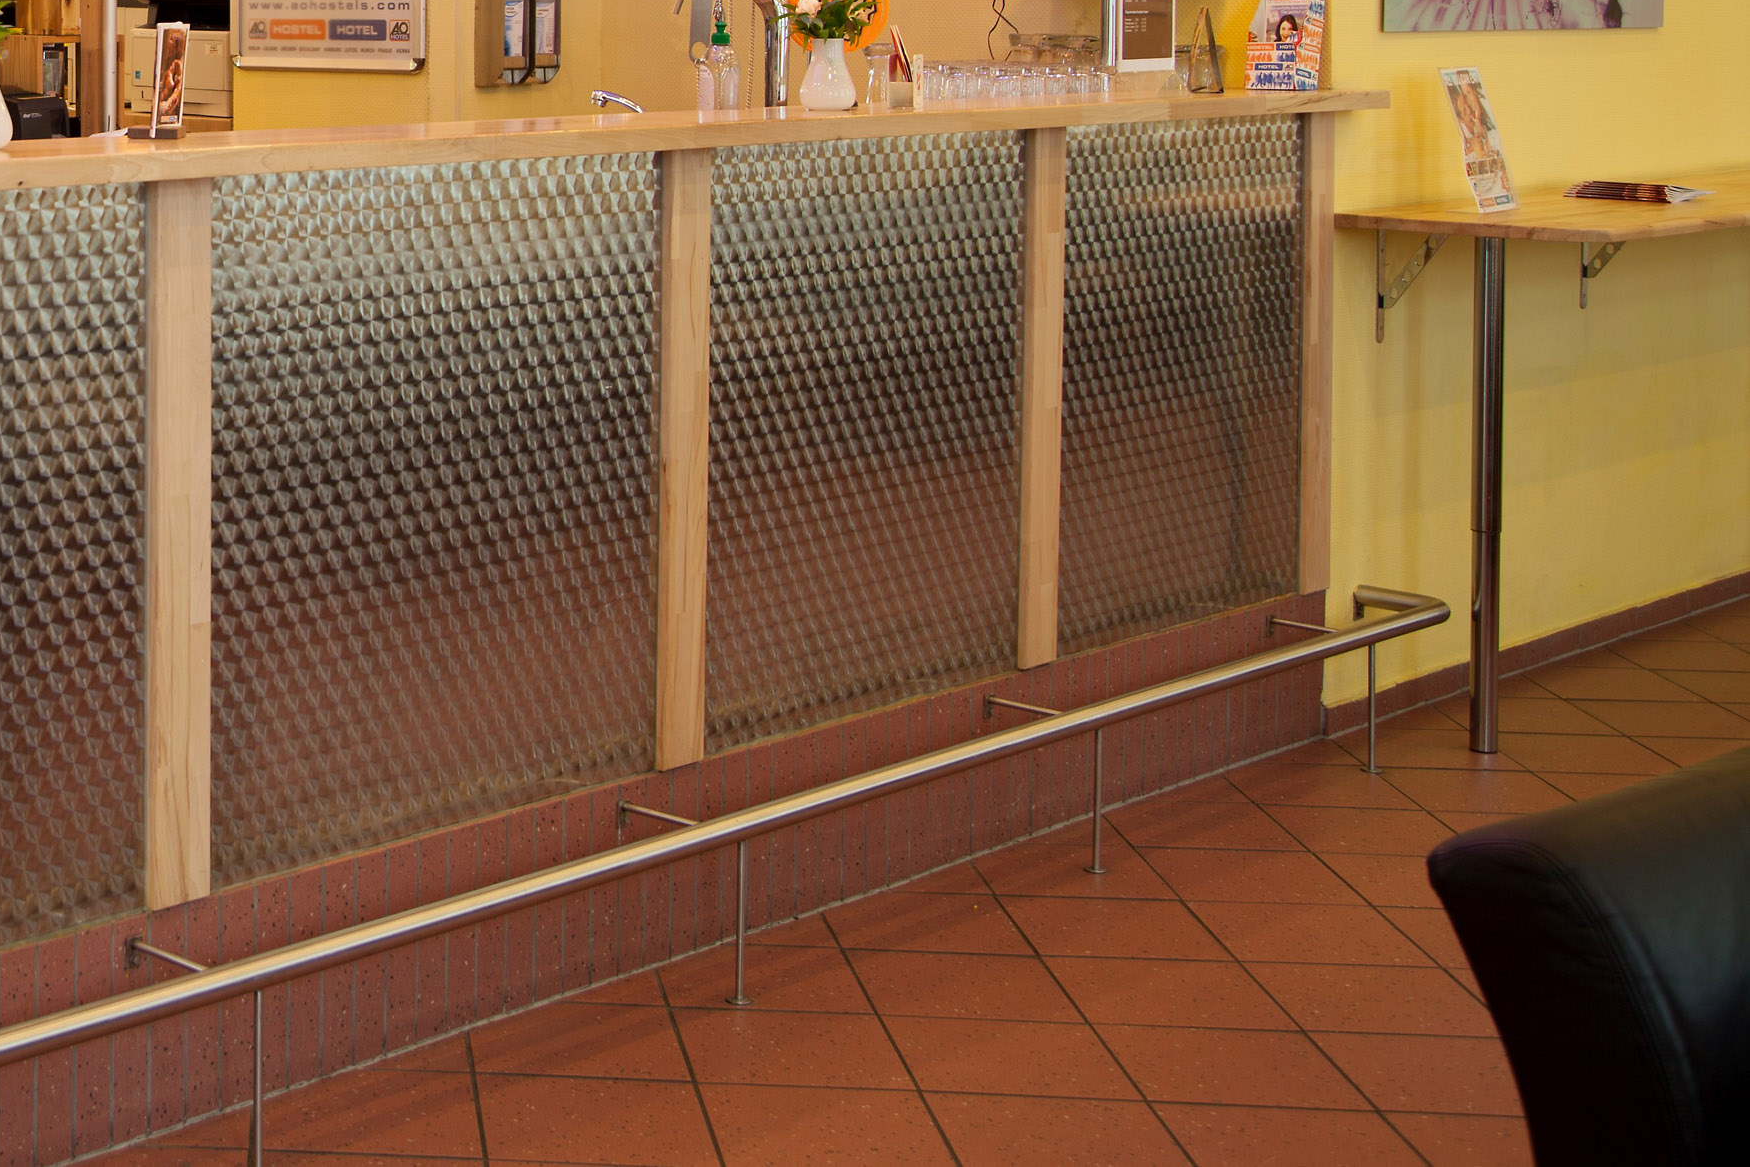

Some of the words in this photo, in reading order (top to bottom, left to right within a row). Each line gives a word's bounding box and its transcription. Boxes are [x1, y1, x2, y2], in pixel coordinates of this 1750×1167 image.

[248, 0, 410, 11] www.aohostels.com
[273, 24, 322, 35] HOSTEL
[336, 25, 378, 35] HOTEL
[391, 21, 409, 34] AO
